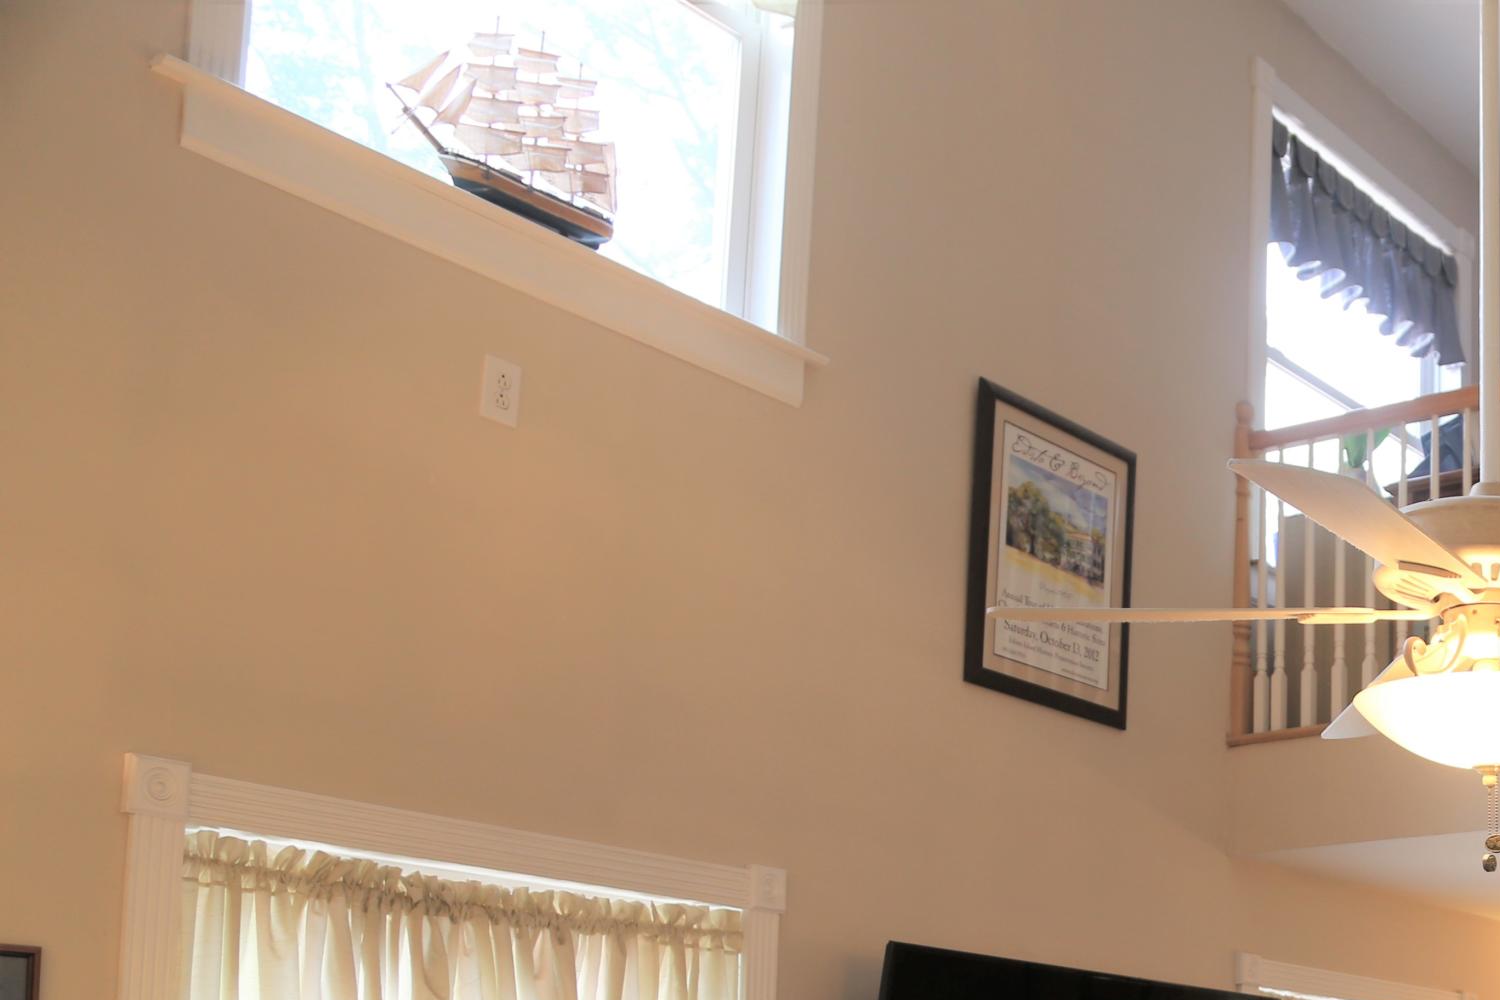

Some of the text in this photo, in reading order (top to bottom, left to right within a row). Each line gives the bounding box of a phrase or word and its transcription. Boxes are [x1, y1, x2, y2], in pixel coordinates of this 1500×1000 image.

[1003, 619, 1038, 641] Saturday,
[1039, 630, 1072, 652] October
[1084, 646, 1099, 662] 2012
